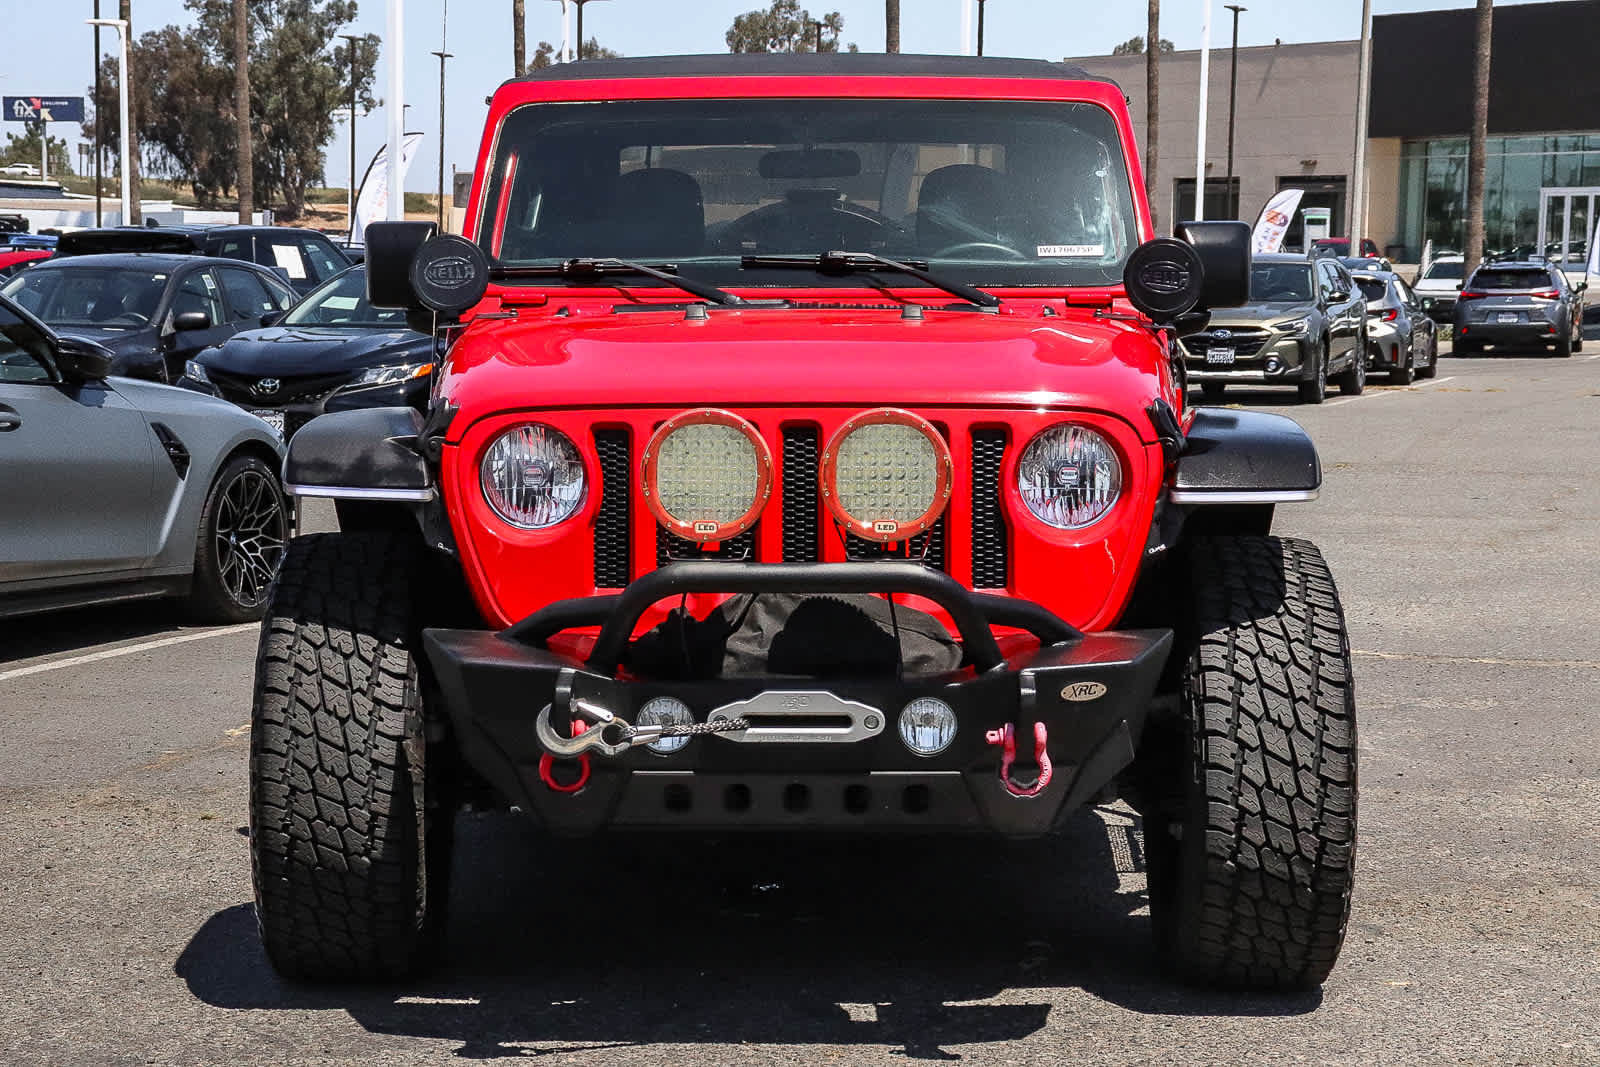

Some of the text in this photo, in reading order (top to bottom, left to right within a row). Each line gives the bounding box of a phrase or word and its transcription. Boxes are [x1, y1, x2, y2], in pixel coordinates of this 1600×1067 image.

[427, 264, 475, 280] HELLA
[697, 523, 715, 531] LED
[1069, 684, 1098, 698] XRC
